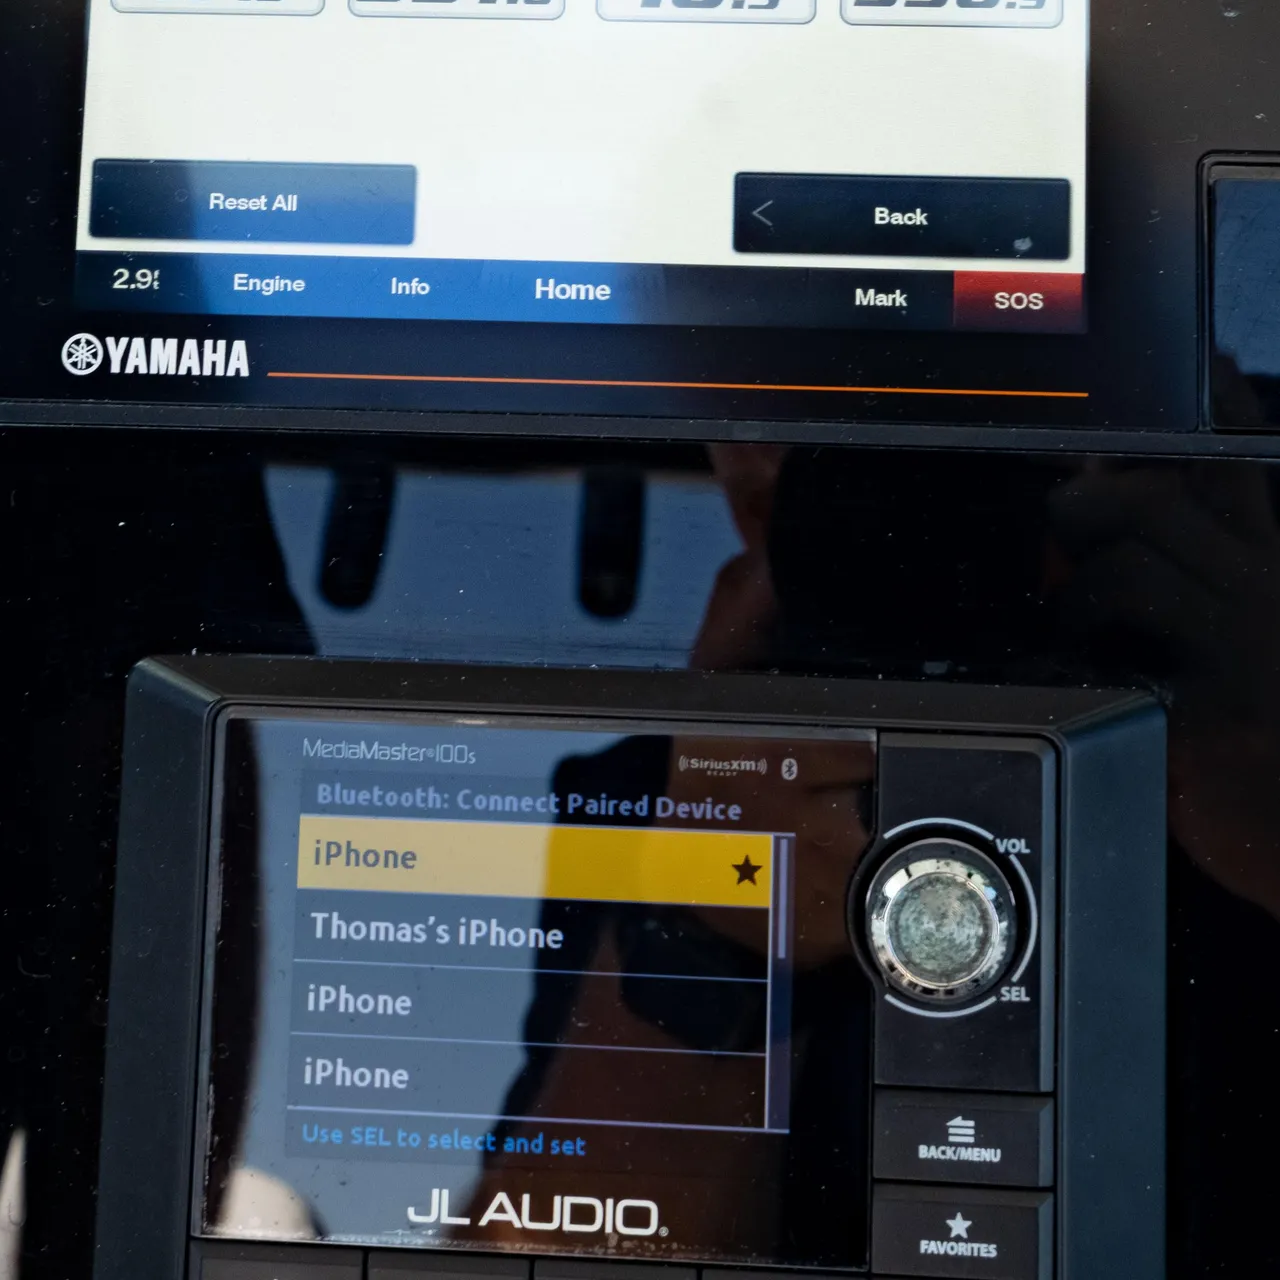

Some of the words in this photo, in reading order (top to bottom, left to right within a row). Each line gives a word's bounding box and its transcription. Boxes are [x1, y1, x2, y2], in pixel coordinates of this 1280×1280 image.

[209, 192, 267, 211] Reset
[272, 194, 298, 212] All
[874, 207, 929, 227] Back
[233, 273, 306, 296] Engine
[391, 277, 430, 296] Info
[534, 278, 611, 302] Home
[854, 288, 908, 308] Mark
[994, 291, 1044, 310] SOS
[105, 336, 250, 378] YAMAHA
[317, 783, 450, 810] Bluetooth:
[457, 788, 560, 815] Connect
[567, 793, 649, 817] Paired
[655, 797, 742, 821] Device
[314, 840, 418, 871] iPhone
[996, 838, 1030, 854] VOL
[310, 912, 451, 945] Thomas's
[458, 919, 564, 950] iPhone
[307, 984, 413, 1016] iPhone
[1000, 986, 1030, 1002] SEL
[304, 1057, 409, 1089] iPhone
[302, 1124, 343, 1145] Use
[350, 1126, 391, 1147] SEL
[397, 1131, 421, 1149] to
[427, 1131, 496, 1152] select
[503, 1133, 544, 1155] and
[550, 1136, 586, 1157] set
[918, 1144, 1001, 1163] BACK/MENU
[407, 1188, 470, 1226] JL
[920, 1240, 997, 1258] FAVORITES
